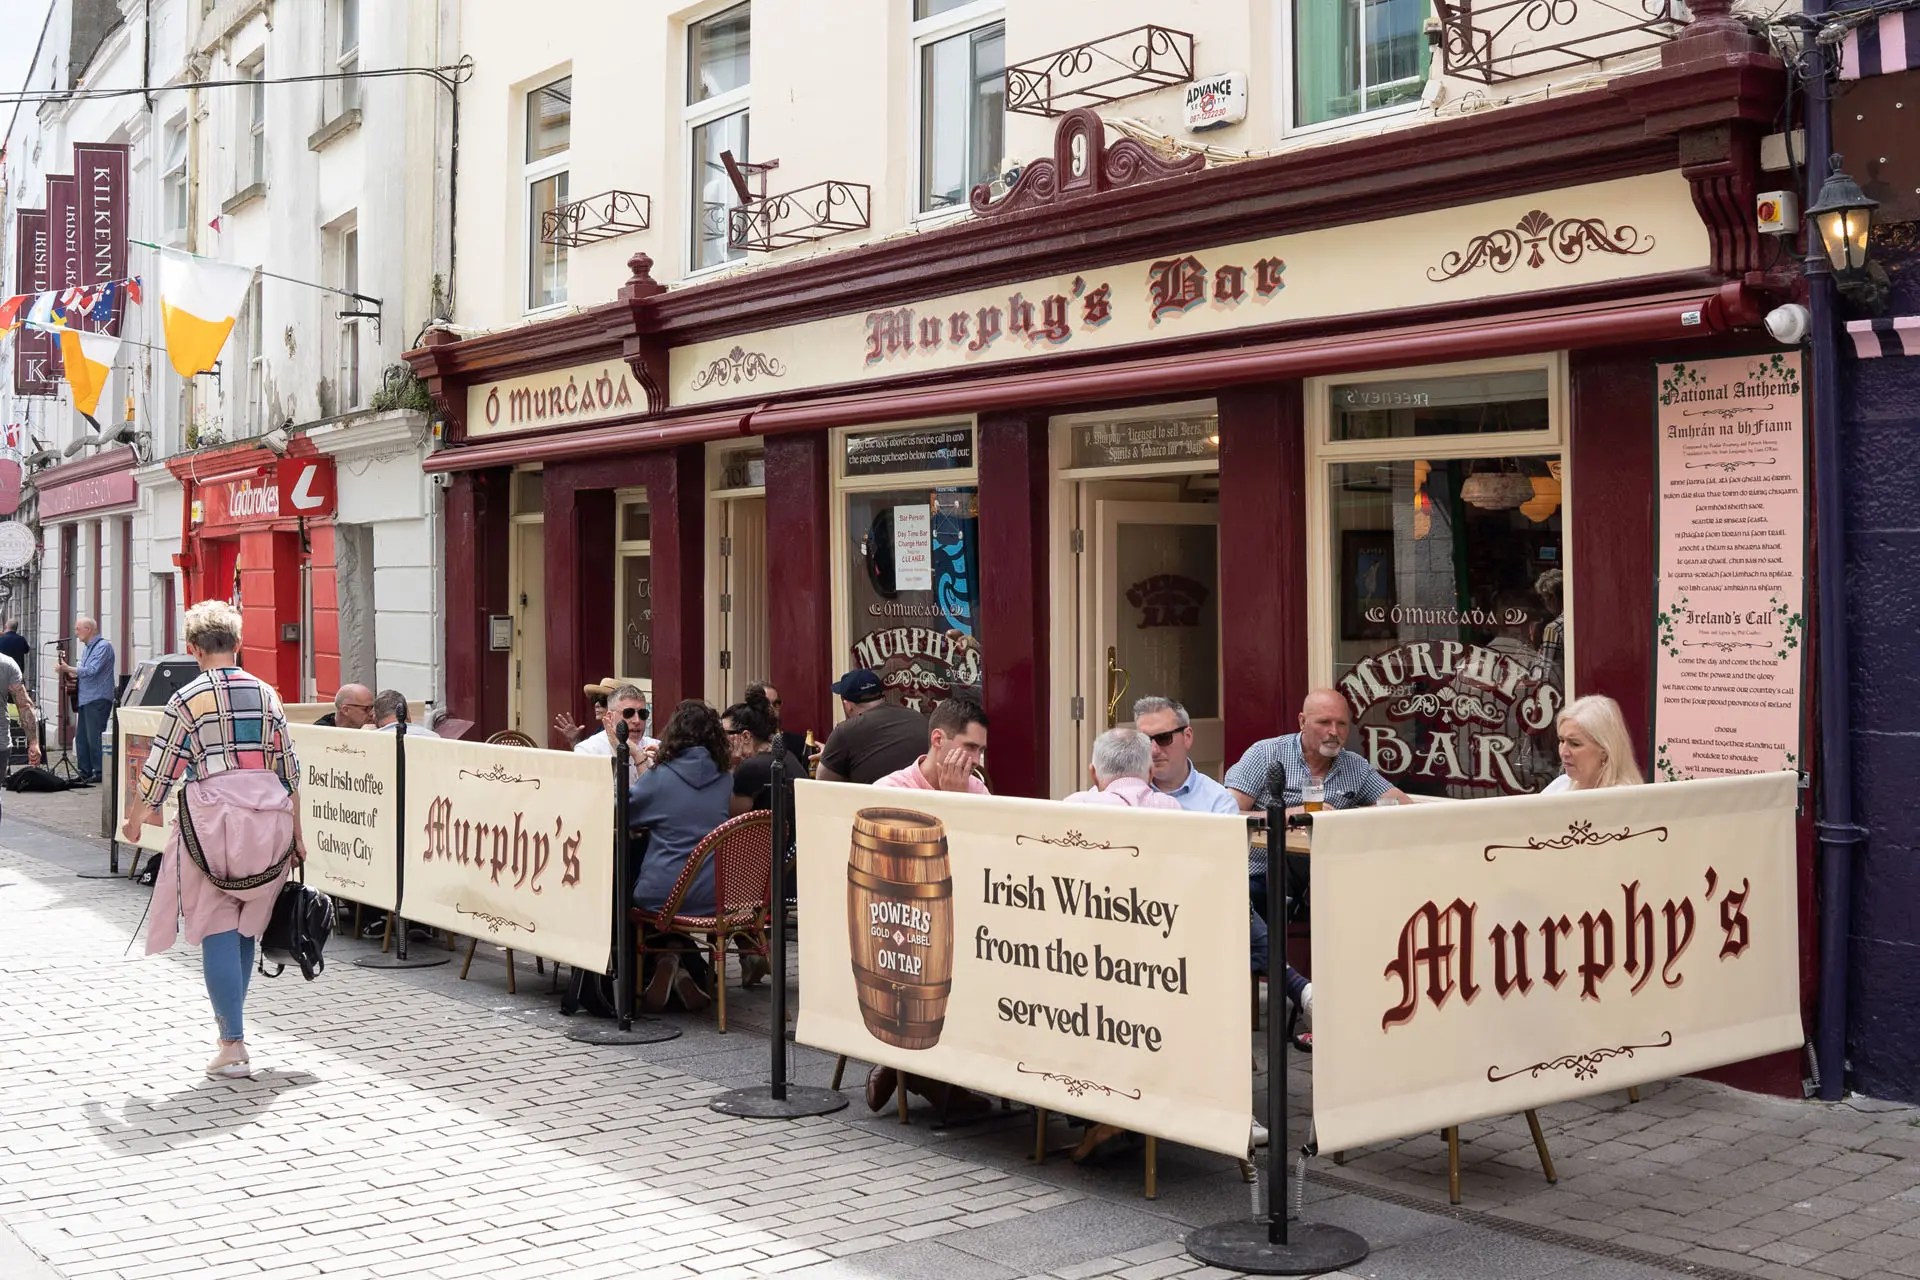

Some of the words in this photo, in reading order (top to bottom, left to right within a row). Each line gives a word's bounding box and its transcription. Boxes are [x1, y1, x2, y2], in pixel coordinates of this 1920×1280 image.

[1186, 79, 1232, 107] ADVANCE
[1072, 134, 1086, 177] 9
[93, 166, 112, 292] KILKENN
[34, 231, 46, 274] IRISH
[864, 275, 1113, 367] Murphy's
[1149, 254, 1286, 325] Bar
[1664, 384, 1728, 405] National
[1733, 381, 1800, 400] Anthems
[1719, 424, 1733, 435] na
[1132, 446, 1139, 458] &
[902, 555, 925, 563] CLEANER
[1686, 610, 1741, 624] Ireland's
[1745, 611, 1772, 625] Call
[1364, 725, 1536, 792] BAR
[309, 765, 329, 788] Best
[330, 768, 352, 791] Irish
[354, 772, 383, 795] coffee
[313, 800, 322, 819] in
[323, 800, 338, 822] the
[340, 802, 366, 826] heart
[367, 808, 378, 828] of
[317, 830, 352, 862] Galway
[353, 837, 373, 866] City
[423, 795, 581, 896] Murphy's
[870, 901, 931, 934] POWERS
[983, 868, 1046, 912] Irish
[1051, 875, 1180, 939] Whiskey
[871, 926, 890, 938] GOLD
[906, 932, 931, 946] LABEL
[1382, 865, 1750, 1034] Murphy's
[878, 949, 896, 970] ON
[898, 953, 922, 976] TAP
[974, 924, 1040, 971] from
[1045, 942, 1088, 978] the
[1094, 944, 1189, 995] barrel
[997, 996, 1089, 1037] served
[1096, 1006, 1162, 1052] here
